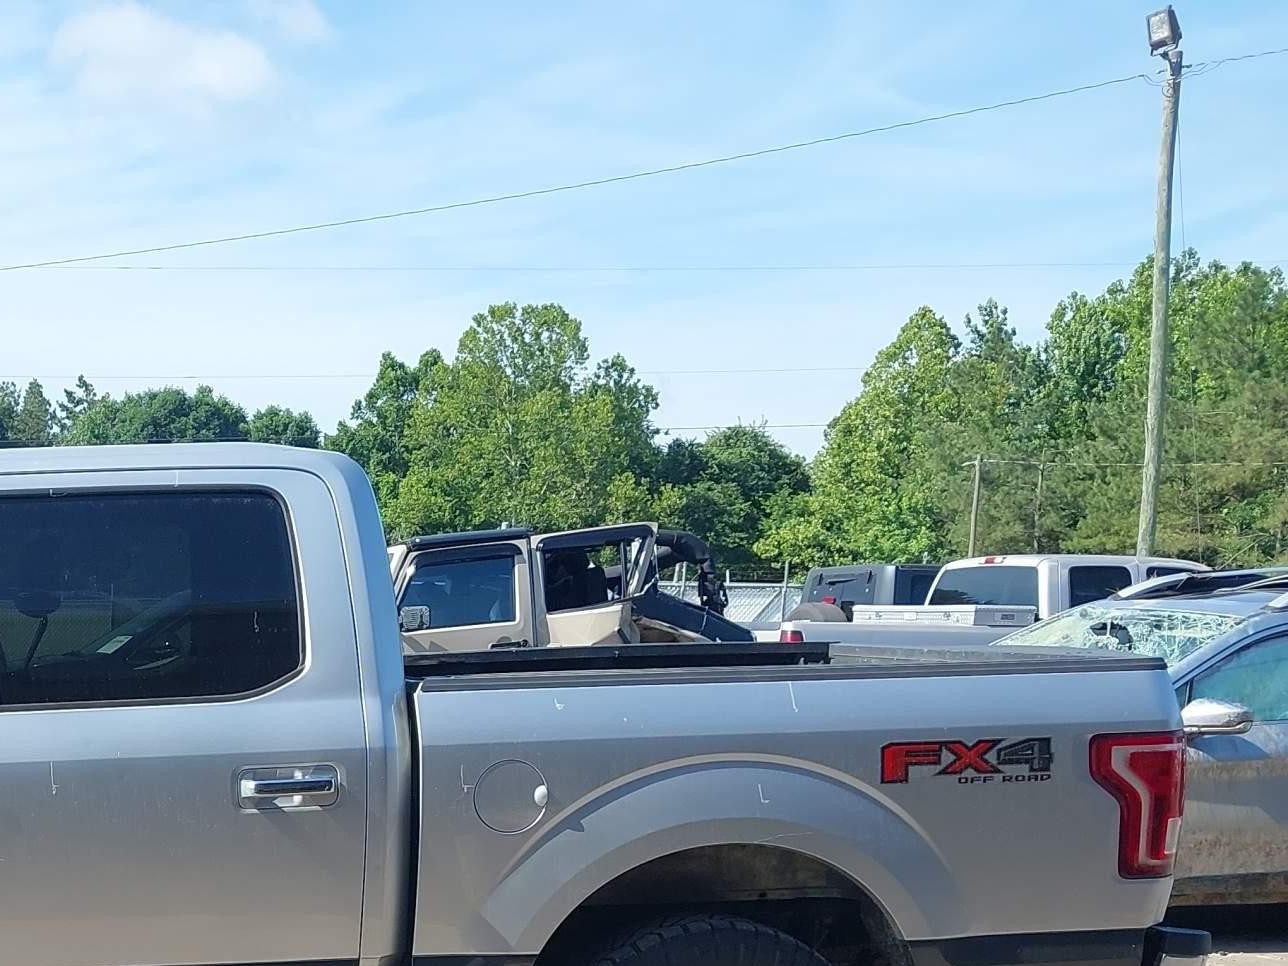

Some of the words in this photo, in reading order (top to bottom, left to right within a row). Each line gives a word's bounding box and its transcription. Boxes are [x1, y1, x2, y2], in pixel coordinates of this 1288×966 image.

[880, 737, 1054, 784] FX4
[958, 775, 994, 785] OFF
[1001, 773, 1052, 783] ROAD
